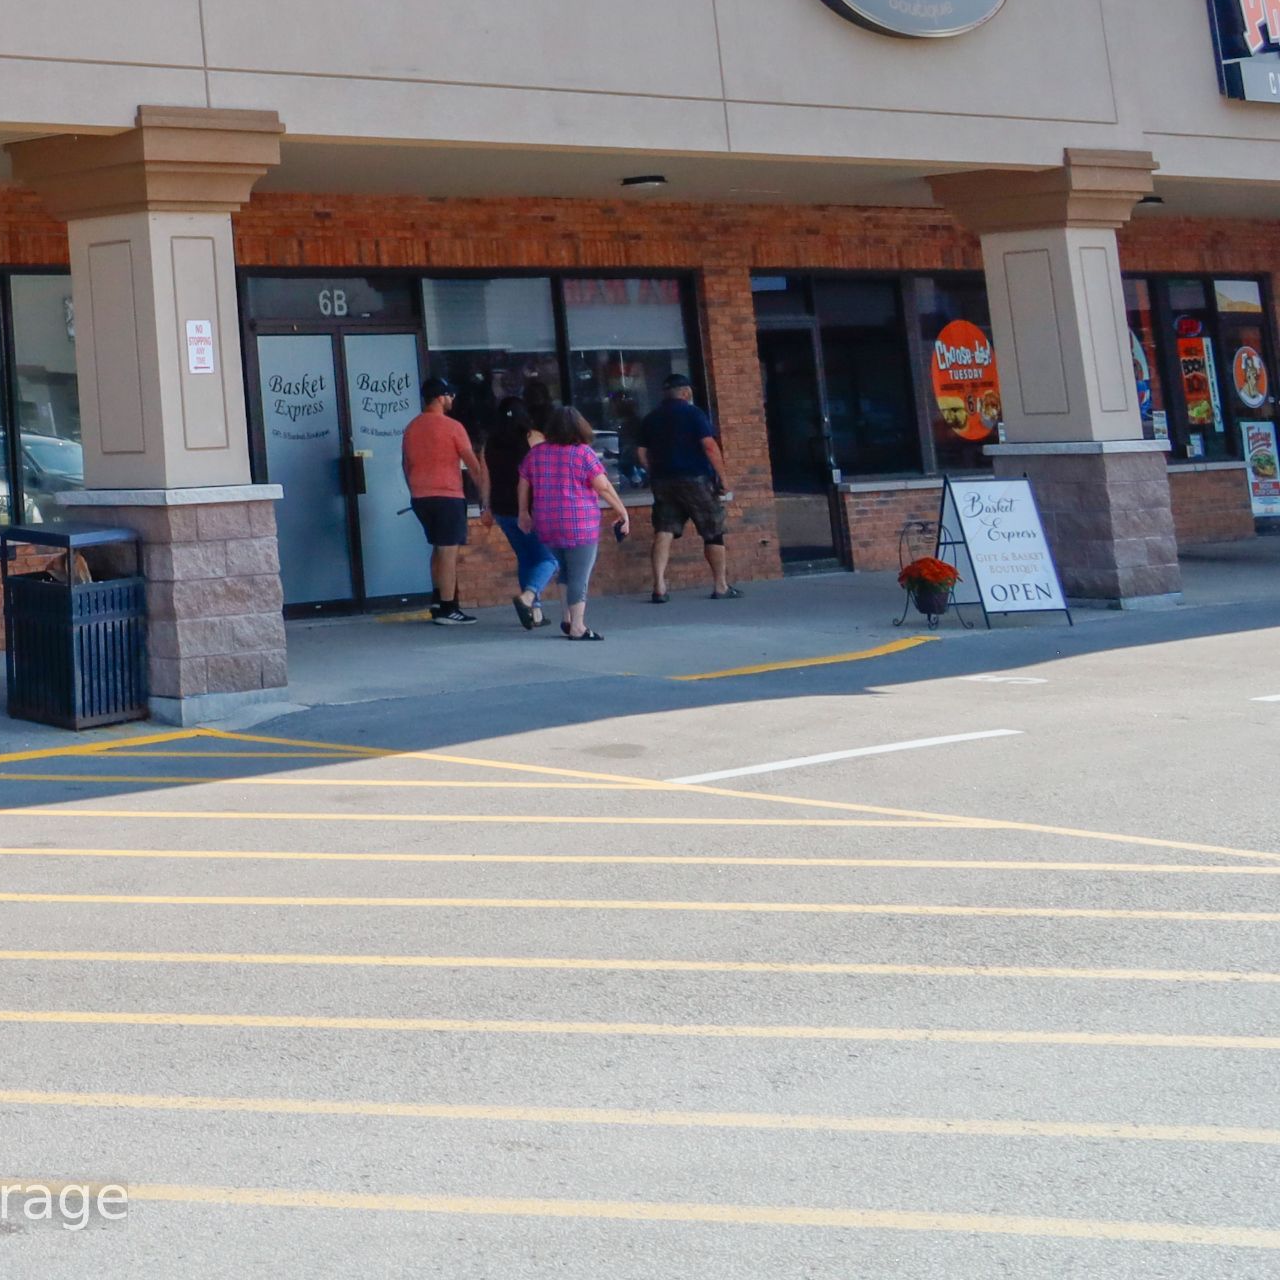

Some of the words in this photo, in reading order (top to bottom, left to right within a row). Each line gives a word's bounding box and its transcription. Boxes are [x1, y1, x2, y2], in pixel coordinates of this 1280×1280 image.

[319, 290, 347, 316] 6B
[269, 373, 327, 399] Basket
[356, 371, 411, 396] Basket
[949, 369, 983, 380] TUESDAY
[274, 399, 324, 422] Express
[362, 397, 410, 419] Express
[963, 491, 1021, 518] Basket
[980, 517, 1037, 542] Express
[989, 564, 1039, 575] BOUTIQUE
[990, 582, 1053, 602] OPEN
